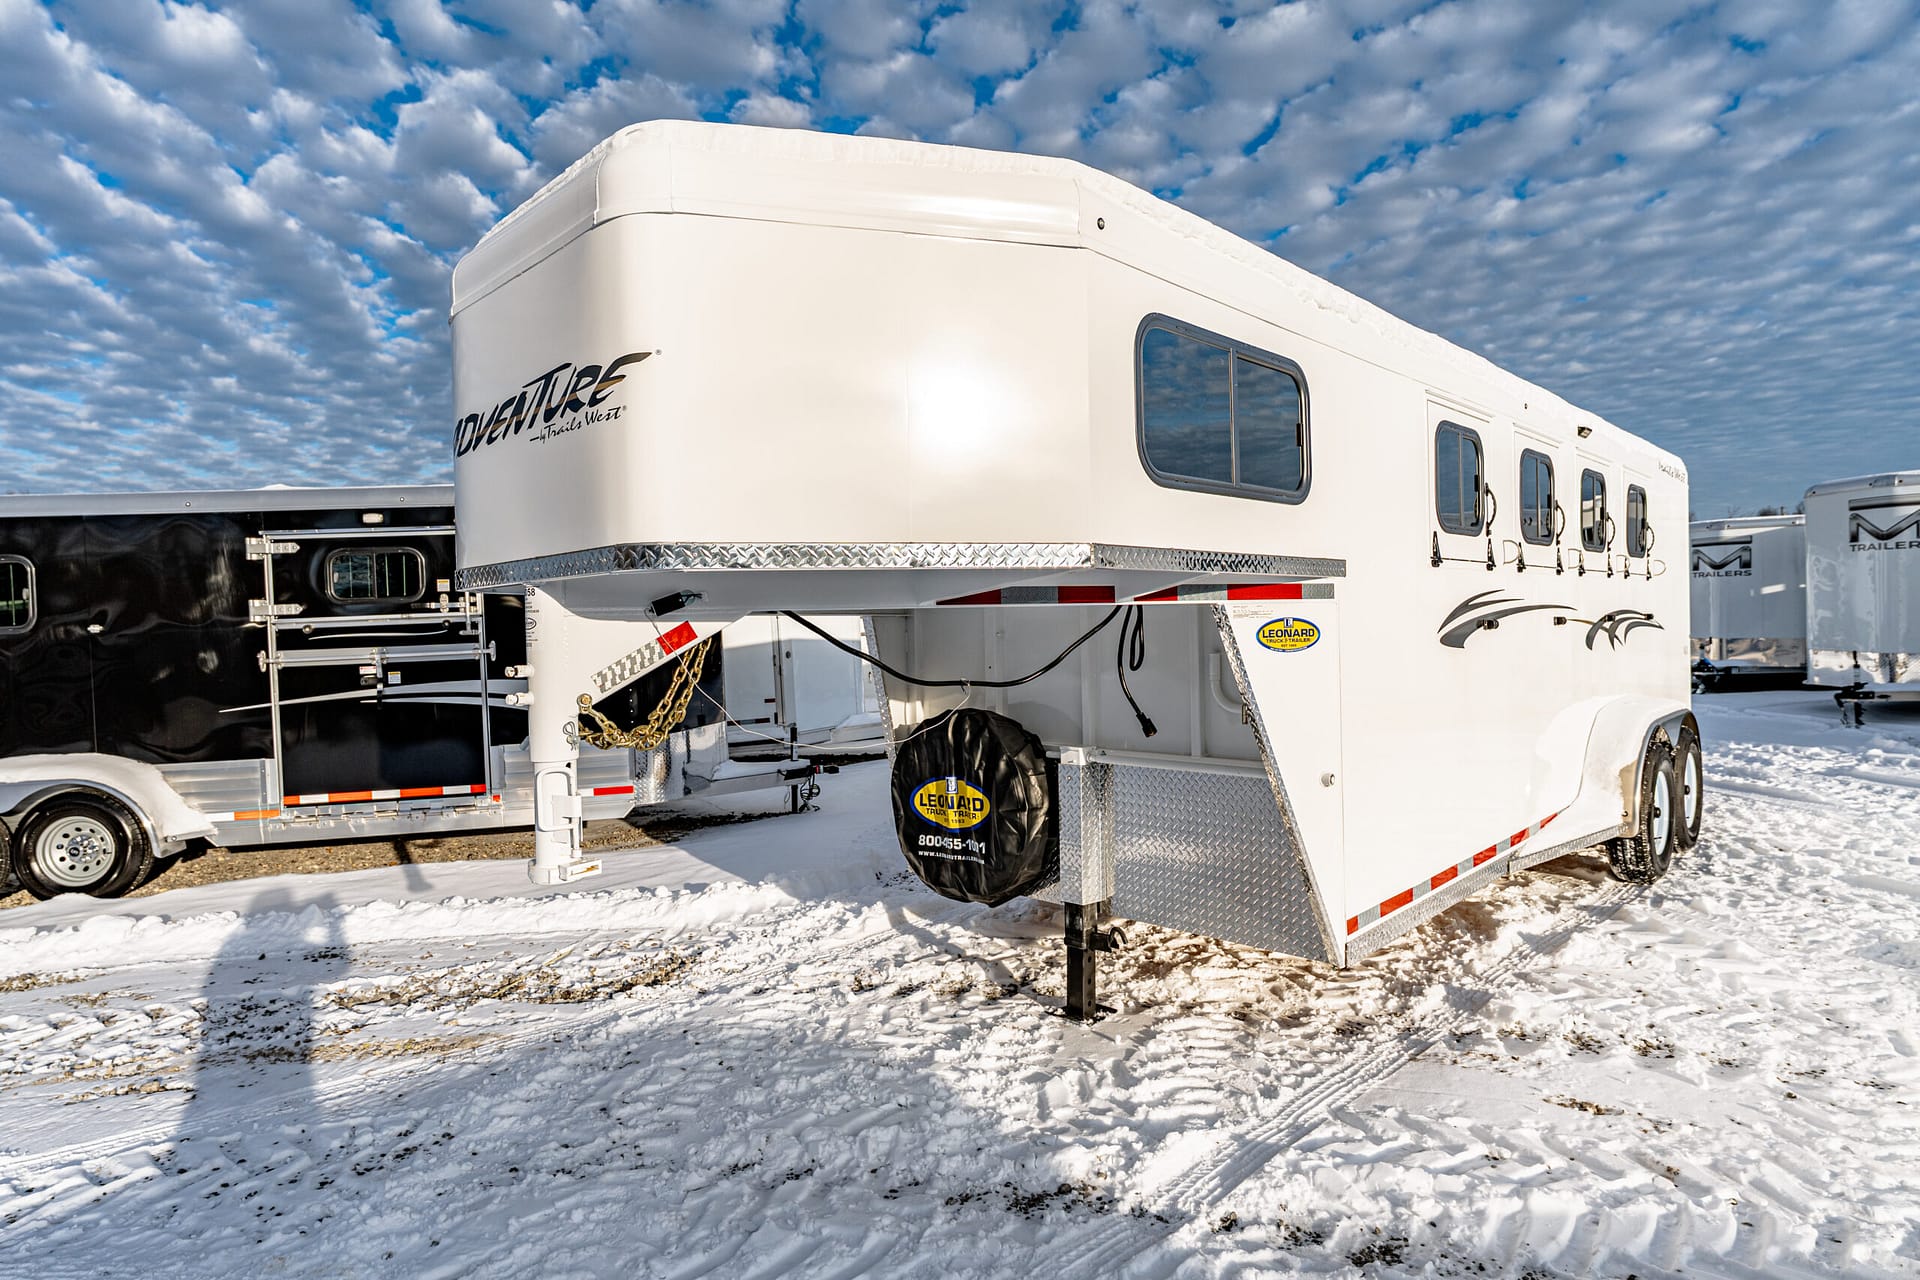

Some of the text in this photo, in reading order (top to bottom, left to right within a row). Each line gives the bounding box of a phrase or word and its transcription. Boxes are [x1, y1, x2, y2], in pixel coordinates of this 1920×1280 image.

[544, 417, 582, 440] Trails
[585, 406, 621, 426] West
[1692, 569, 1752, 578] TRAILERS
[1262, 628, 1315, 639] LEONARD
